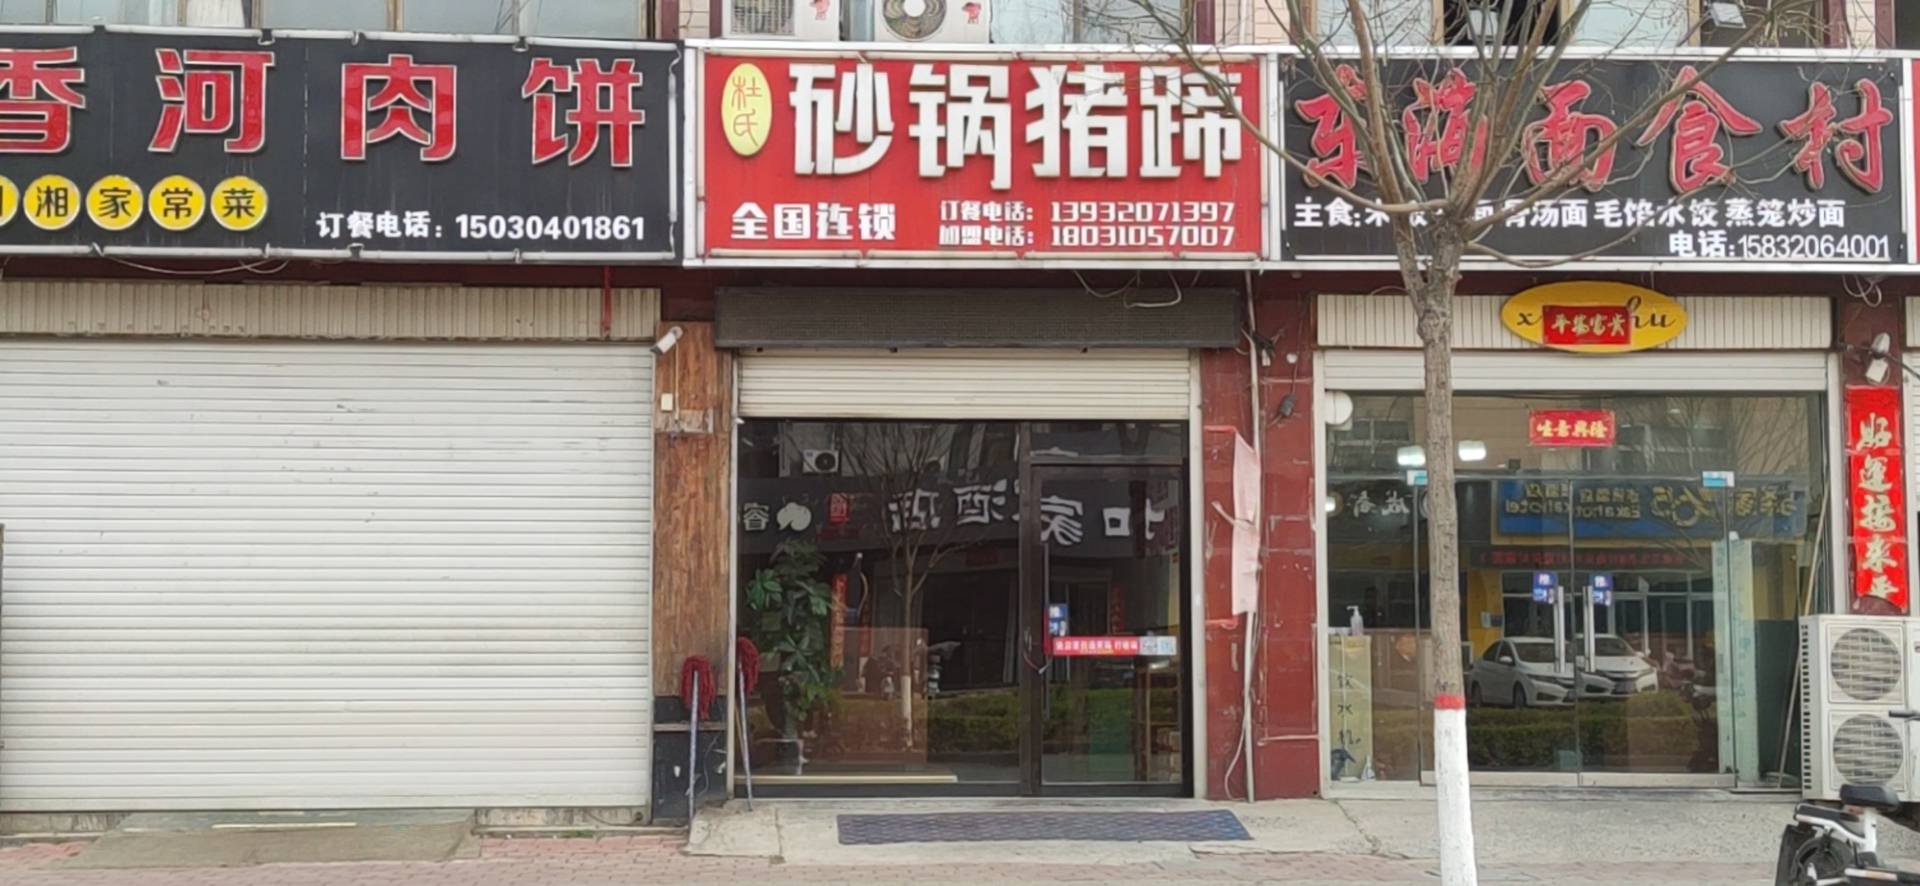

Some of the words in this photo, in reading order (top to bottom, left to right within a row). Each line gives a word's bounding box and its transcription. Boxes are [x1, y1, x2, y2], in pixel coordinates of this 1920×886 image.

[0, 48, 646, 167] 香河肉饼
[731, 75, 763, 147] 杜氏
[788, 62, 1244, 190] 砂锅猪蹄
[0, 185, 257, 220] 湘家常菜
[731, 202, 897, 240] 全国连锁
